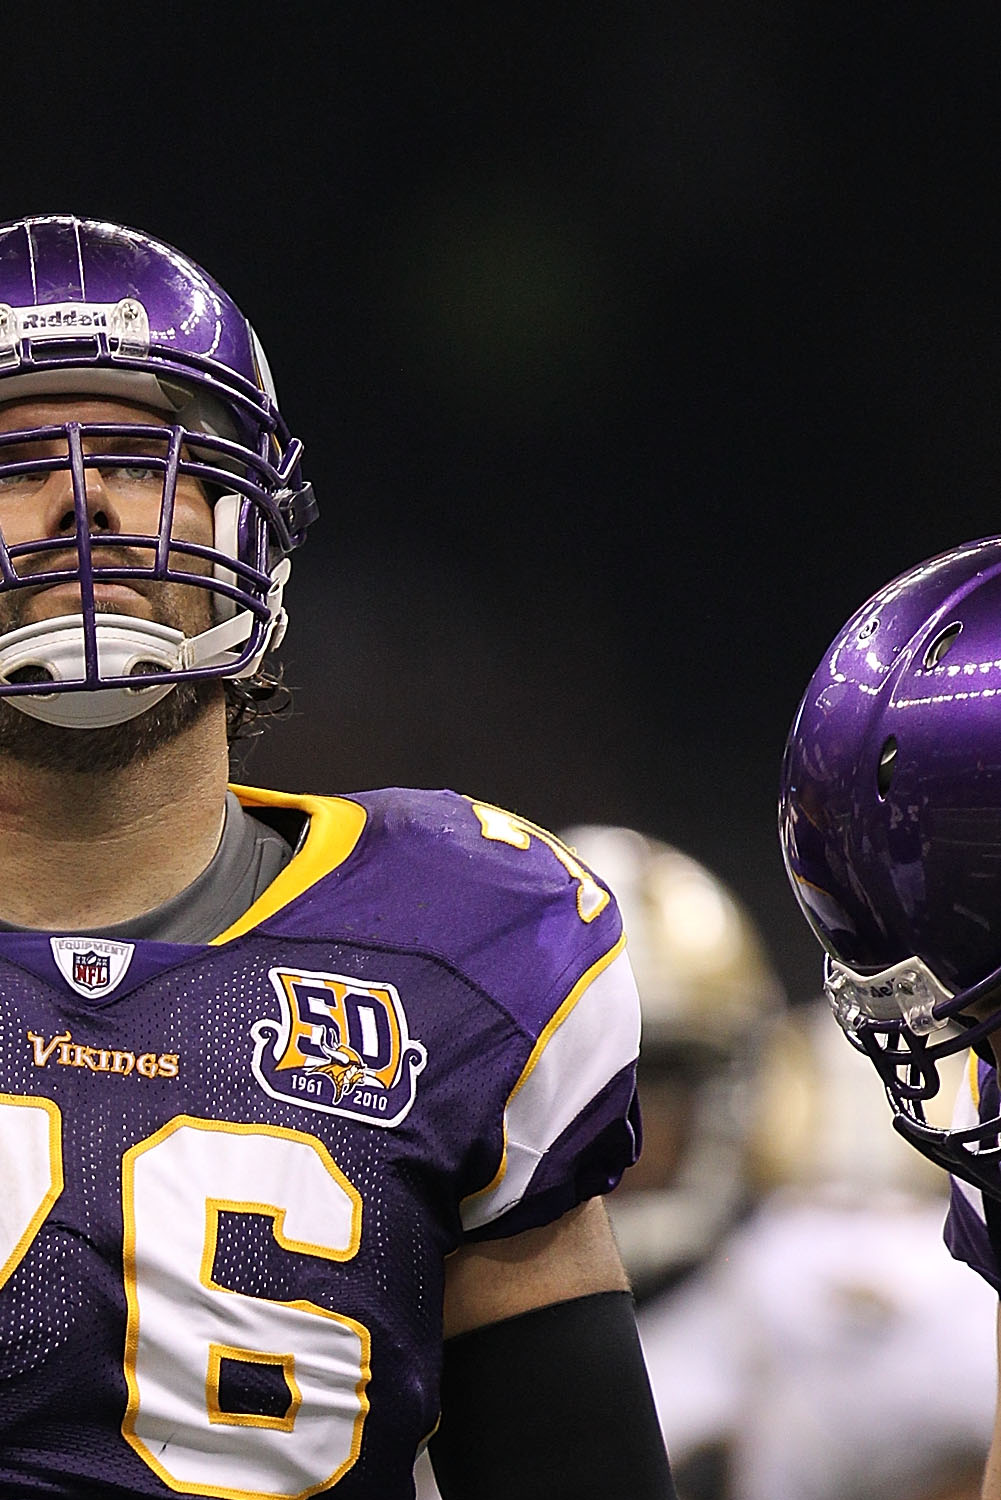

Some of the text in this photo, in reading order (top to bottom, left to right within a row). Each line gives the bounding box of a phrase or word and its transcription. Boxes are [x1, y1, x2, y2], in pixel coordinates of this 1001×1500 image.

[22, 310, 107, 330] Riddell
[58, 940, 126, 956] EQUIPMENT
[76, 964, 107, 985] NFL
[291, 982, 393, 1071] 50
[291, 1074, 388, 1111] 1961 2010
